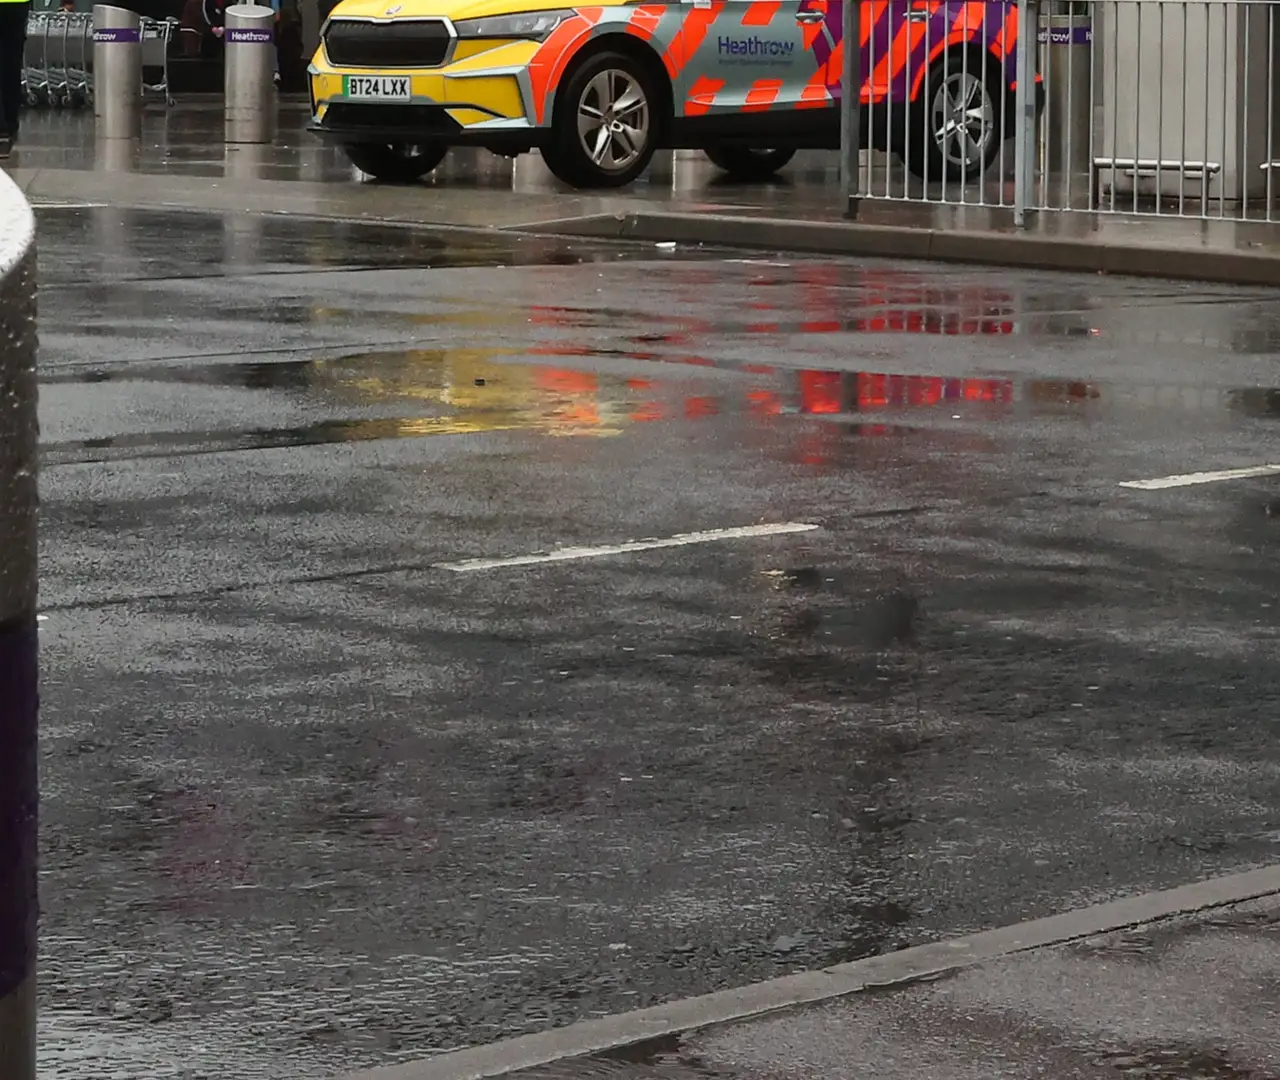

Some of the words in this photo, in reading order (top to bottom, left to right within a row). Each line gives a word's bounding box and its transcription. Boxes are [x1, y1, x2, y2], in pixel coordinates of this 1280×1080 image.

[231, 31, 270, 41] Heathrow
[718, 35, 794, 56] Heathrow
[350, 78, 380, 96] BT24
[382, 79, 407, 97] LXX
